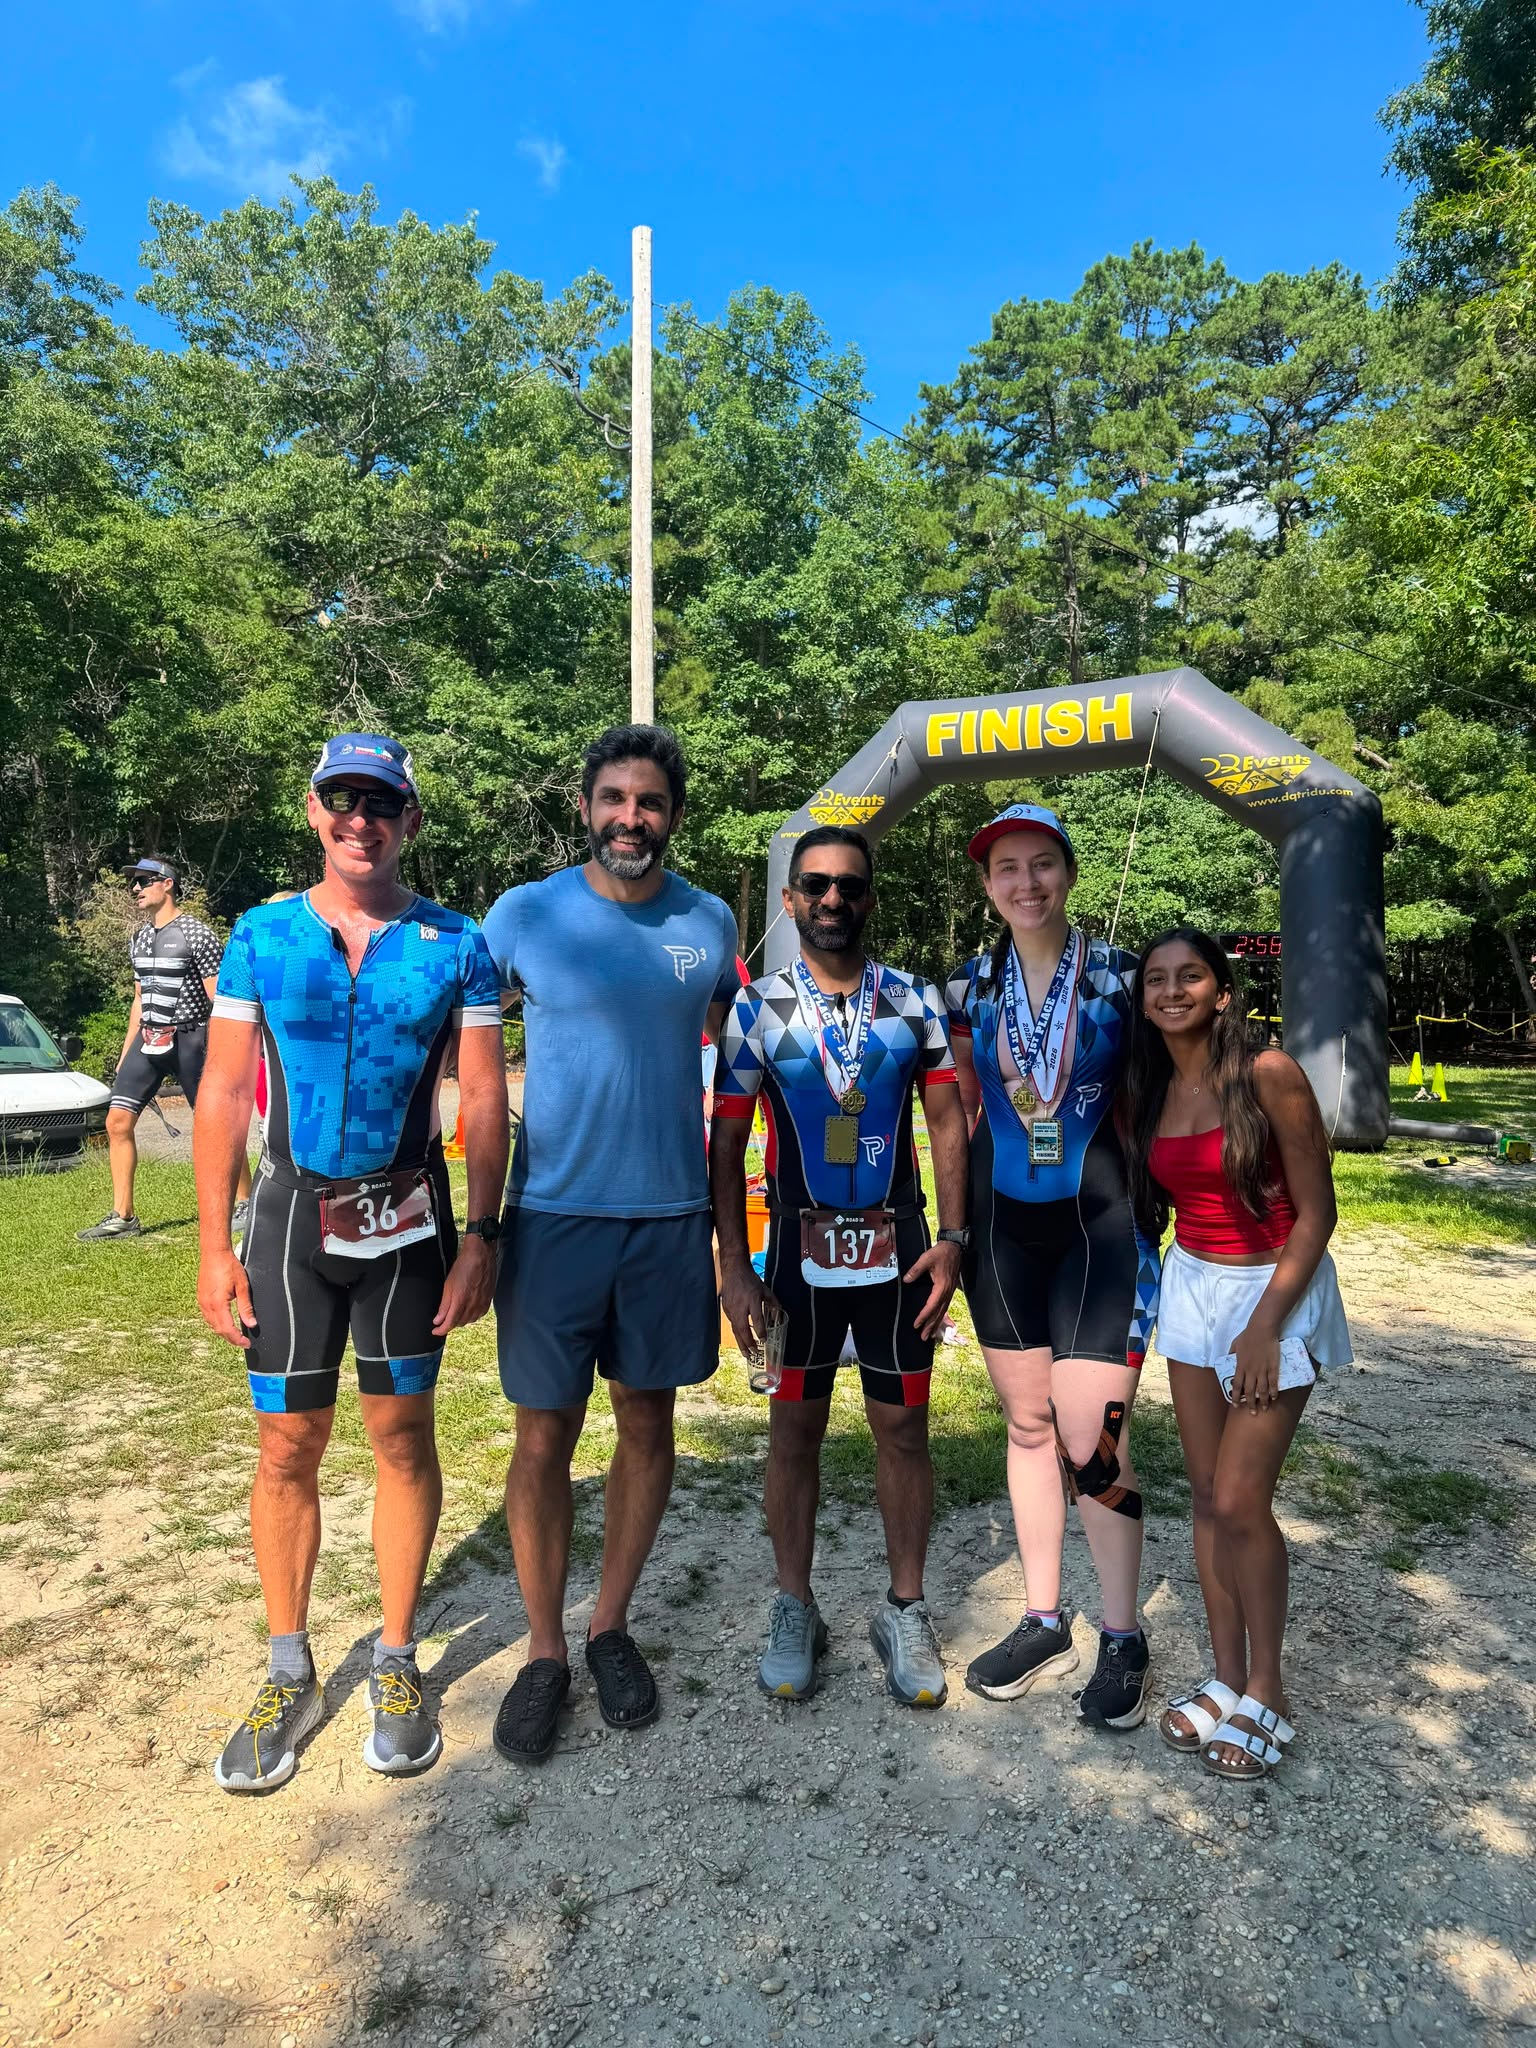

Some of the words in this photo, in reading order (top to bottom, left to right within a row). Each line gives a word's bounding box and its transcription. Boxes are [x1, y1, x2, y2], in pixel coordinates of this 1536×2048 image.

[926, 692, 1134, 757] FINISH
[1247, 787, 1354, 808] www.dqtridu.com
[803, 977, 818, 991] 1ST
[1060, 984, 1070, 1005] 2026
[862, 990, 873, 1024] PLACE
[860, 1024, 869, 1043] 1ST
[1009, 1026, 1019, 1044] 1ST
[1028, 1036, 1039, 1055] 1ST
[1035, 997, 1056, 1035] PLACE
[837, 1044, 851, 1062] 1ST
[1049, 1047, 1058, 1070] 2026
[841, 1094, 866, 1106] GOLD
[1012, 1094, 1035, 1105] GOLD
[356, 1195, 398, 1236] 36
[824, 1229, 876, 1265] 137
